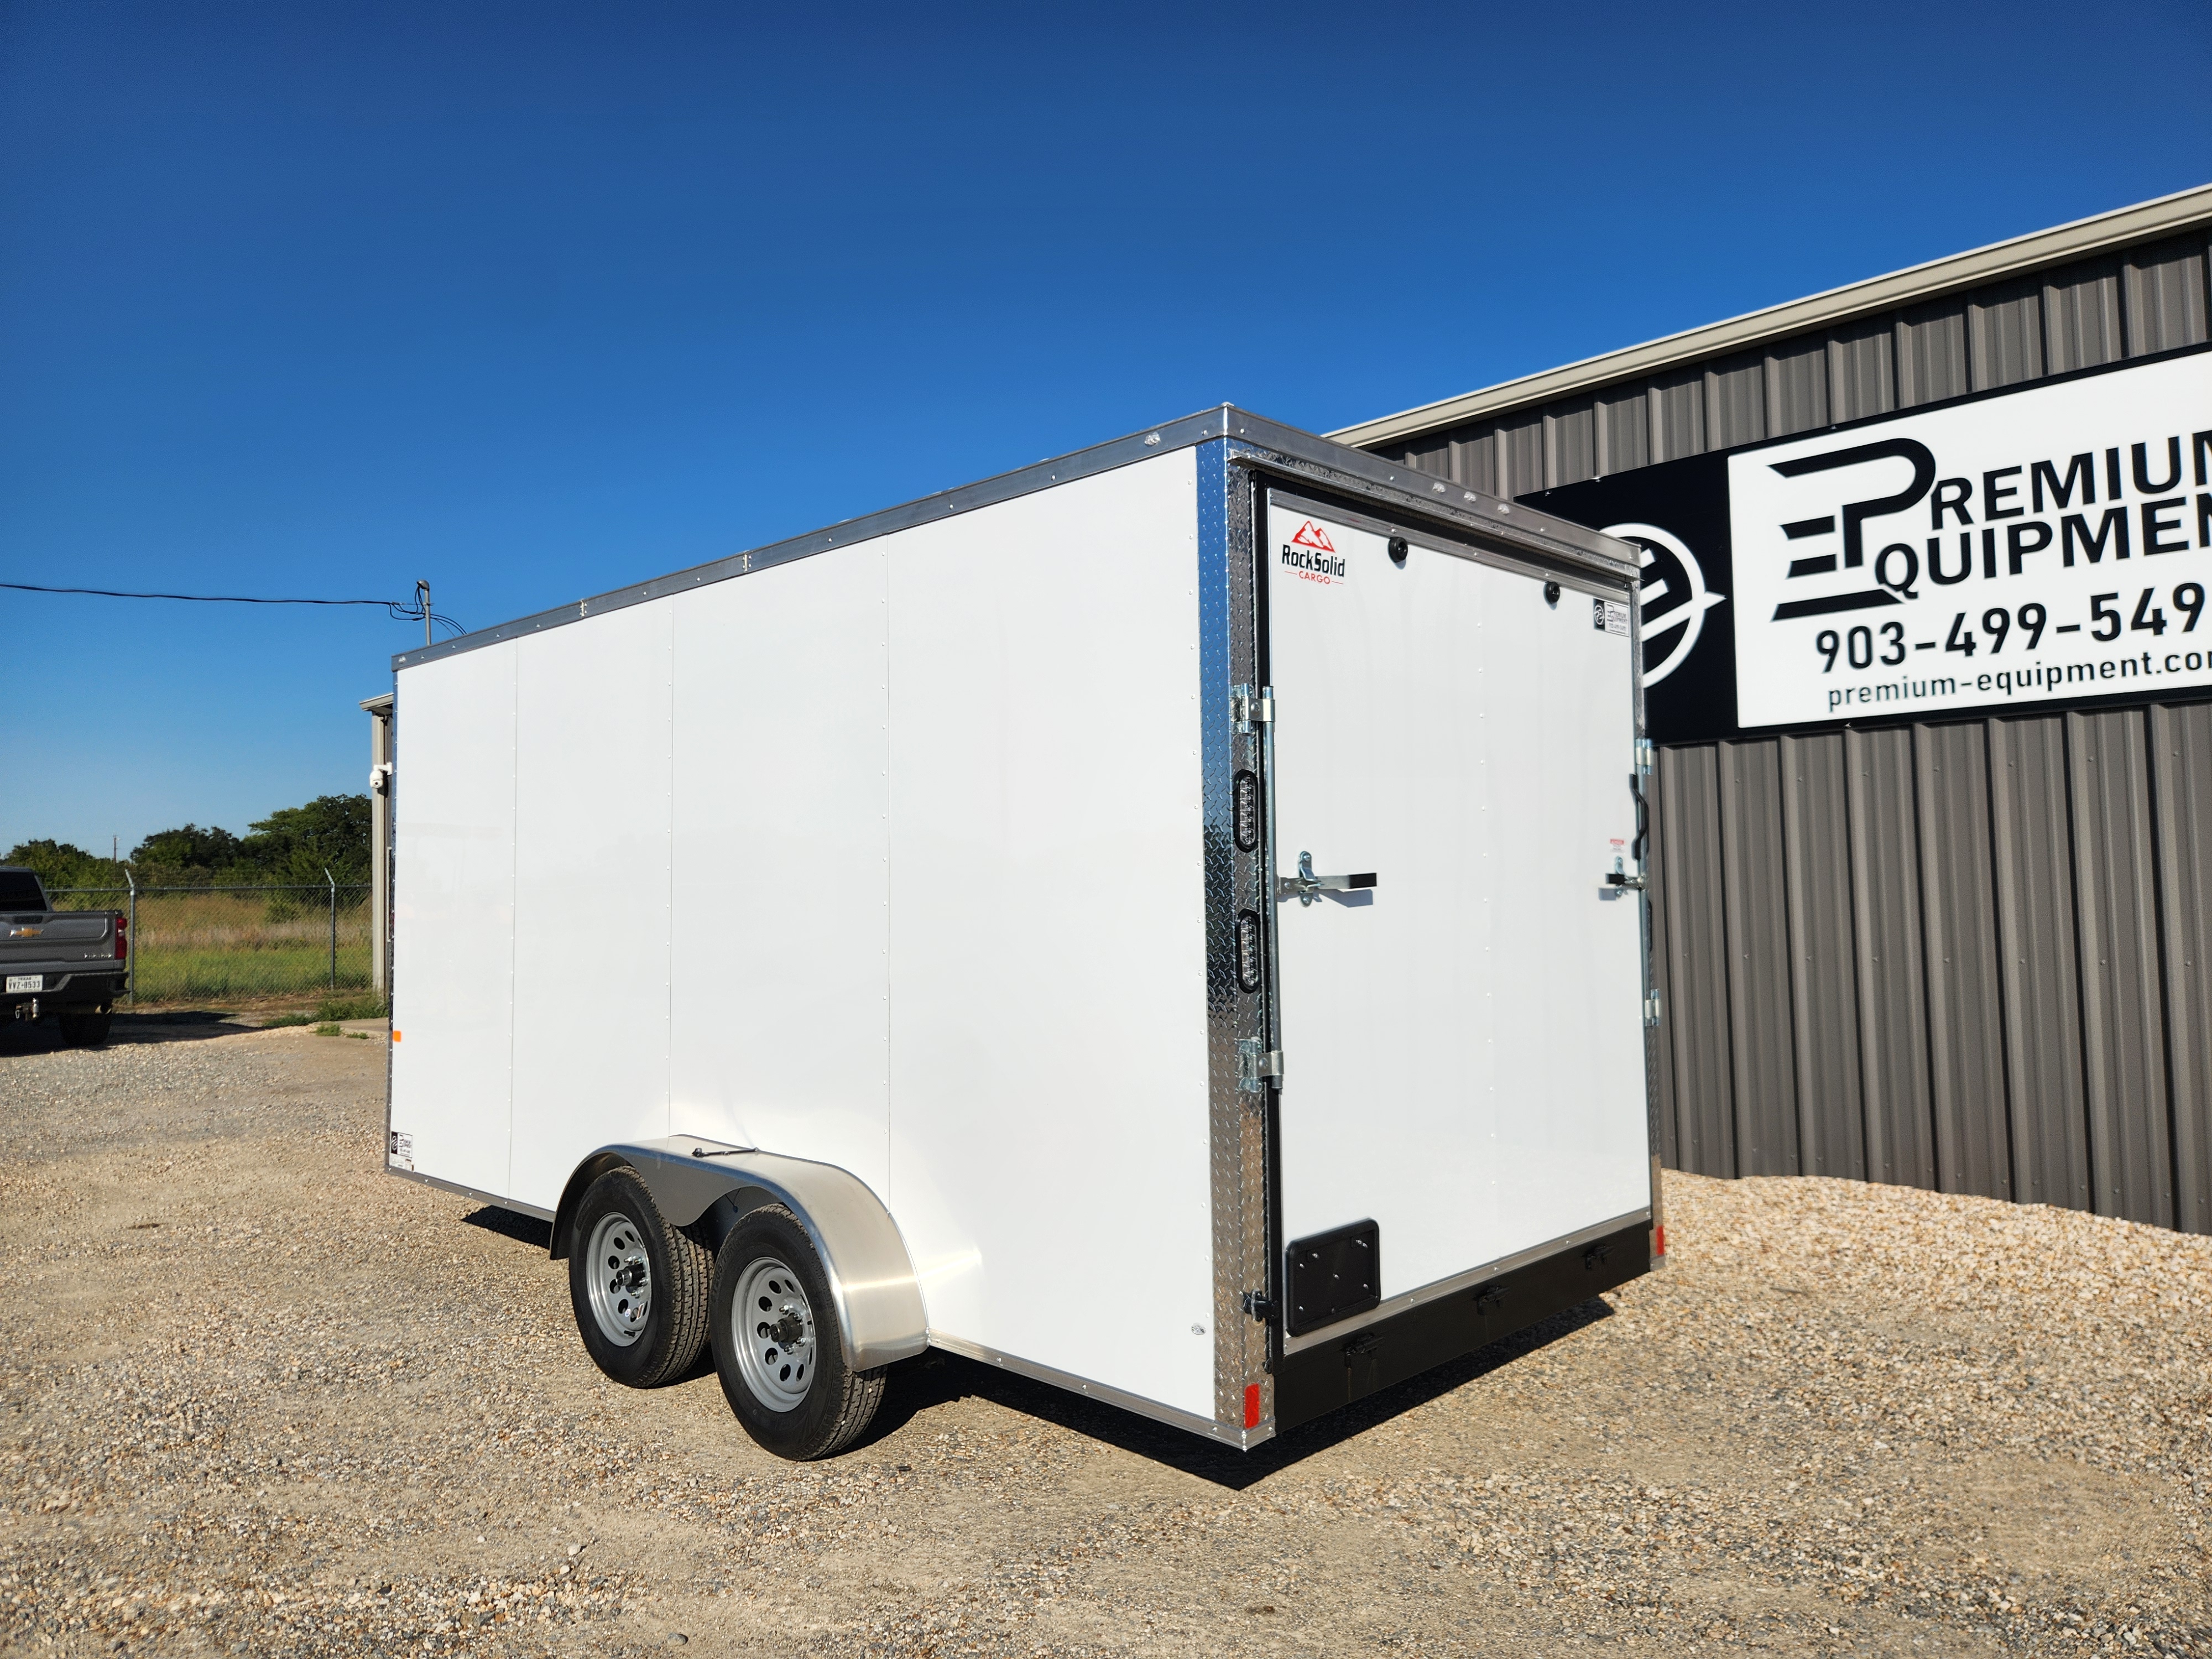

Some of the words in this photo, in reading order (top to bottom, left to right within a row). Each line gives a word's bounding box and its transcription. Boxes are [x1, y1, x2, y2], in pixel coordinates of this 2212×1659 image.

[1282, 544, 1345, 577] RockSolid
[1299, 571, 1331, 584] CARGO
[1816, 582, 2205, 674] 903-499-549
[1828, 651, 2212, 712] premium-equipment.co
